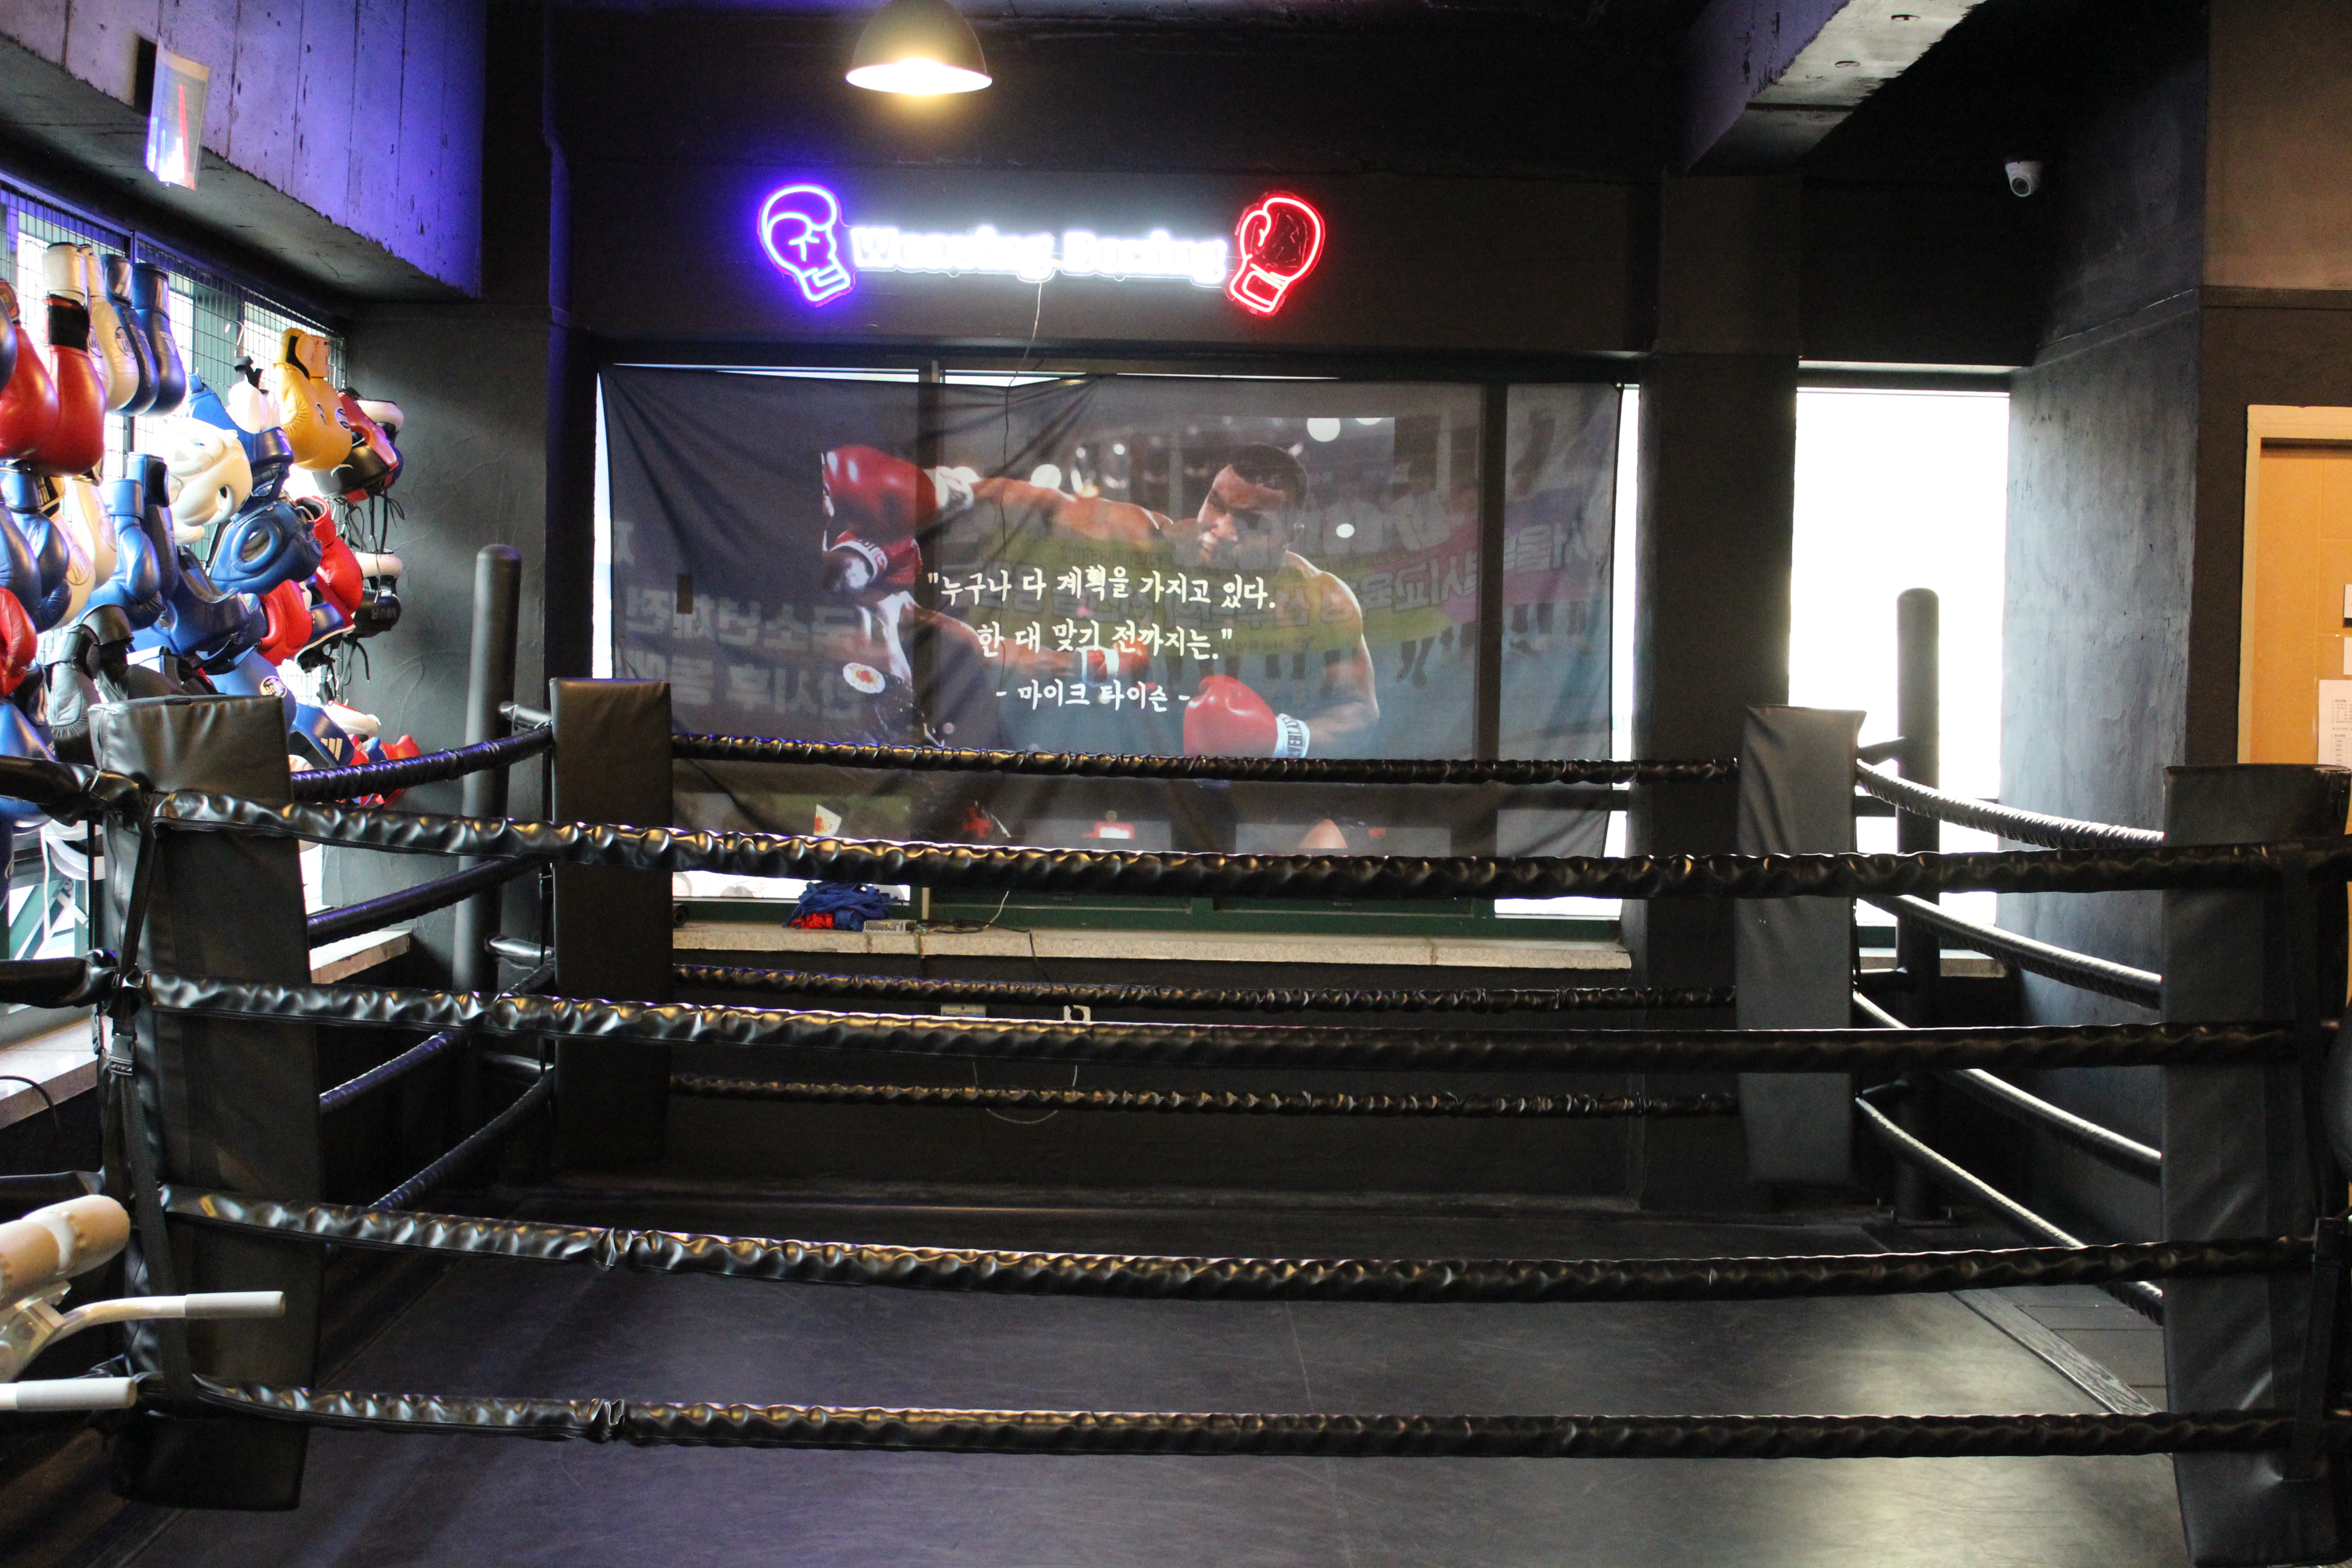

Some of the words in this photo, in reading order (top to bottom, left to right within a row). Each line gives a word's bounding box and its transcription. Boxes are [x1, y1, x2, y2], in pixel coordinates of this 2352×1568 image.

[850, 225, 1054, 279] Weaving
[1062, 228, 1229, 284] Boxing
[928, 569, 1012, 606] "누구나
[1023, 568, 1046, 600] 다
[1057, 564, 1129, 601] 계획을
[1140, 570, 1211, 603] 가지고
[1221, 574, 1275, 609] 있다.
[977, 621, 1005, 657] 한
[1015, 622, 1040, 653] 대
[1052, 618, 1100, 652] 맞기
[1111, 623, 1233, 660] 전까지는."
[1019, 679, 1090, 710] 마이크
[1099, 680, 1168, 712] 타이슨
